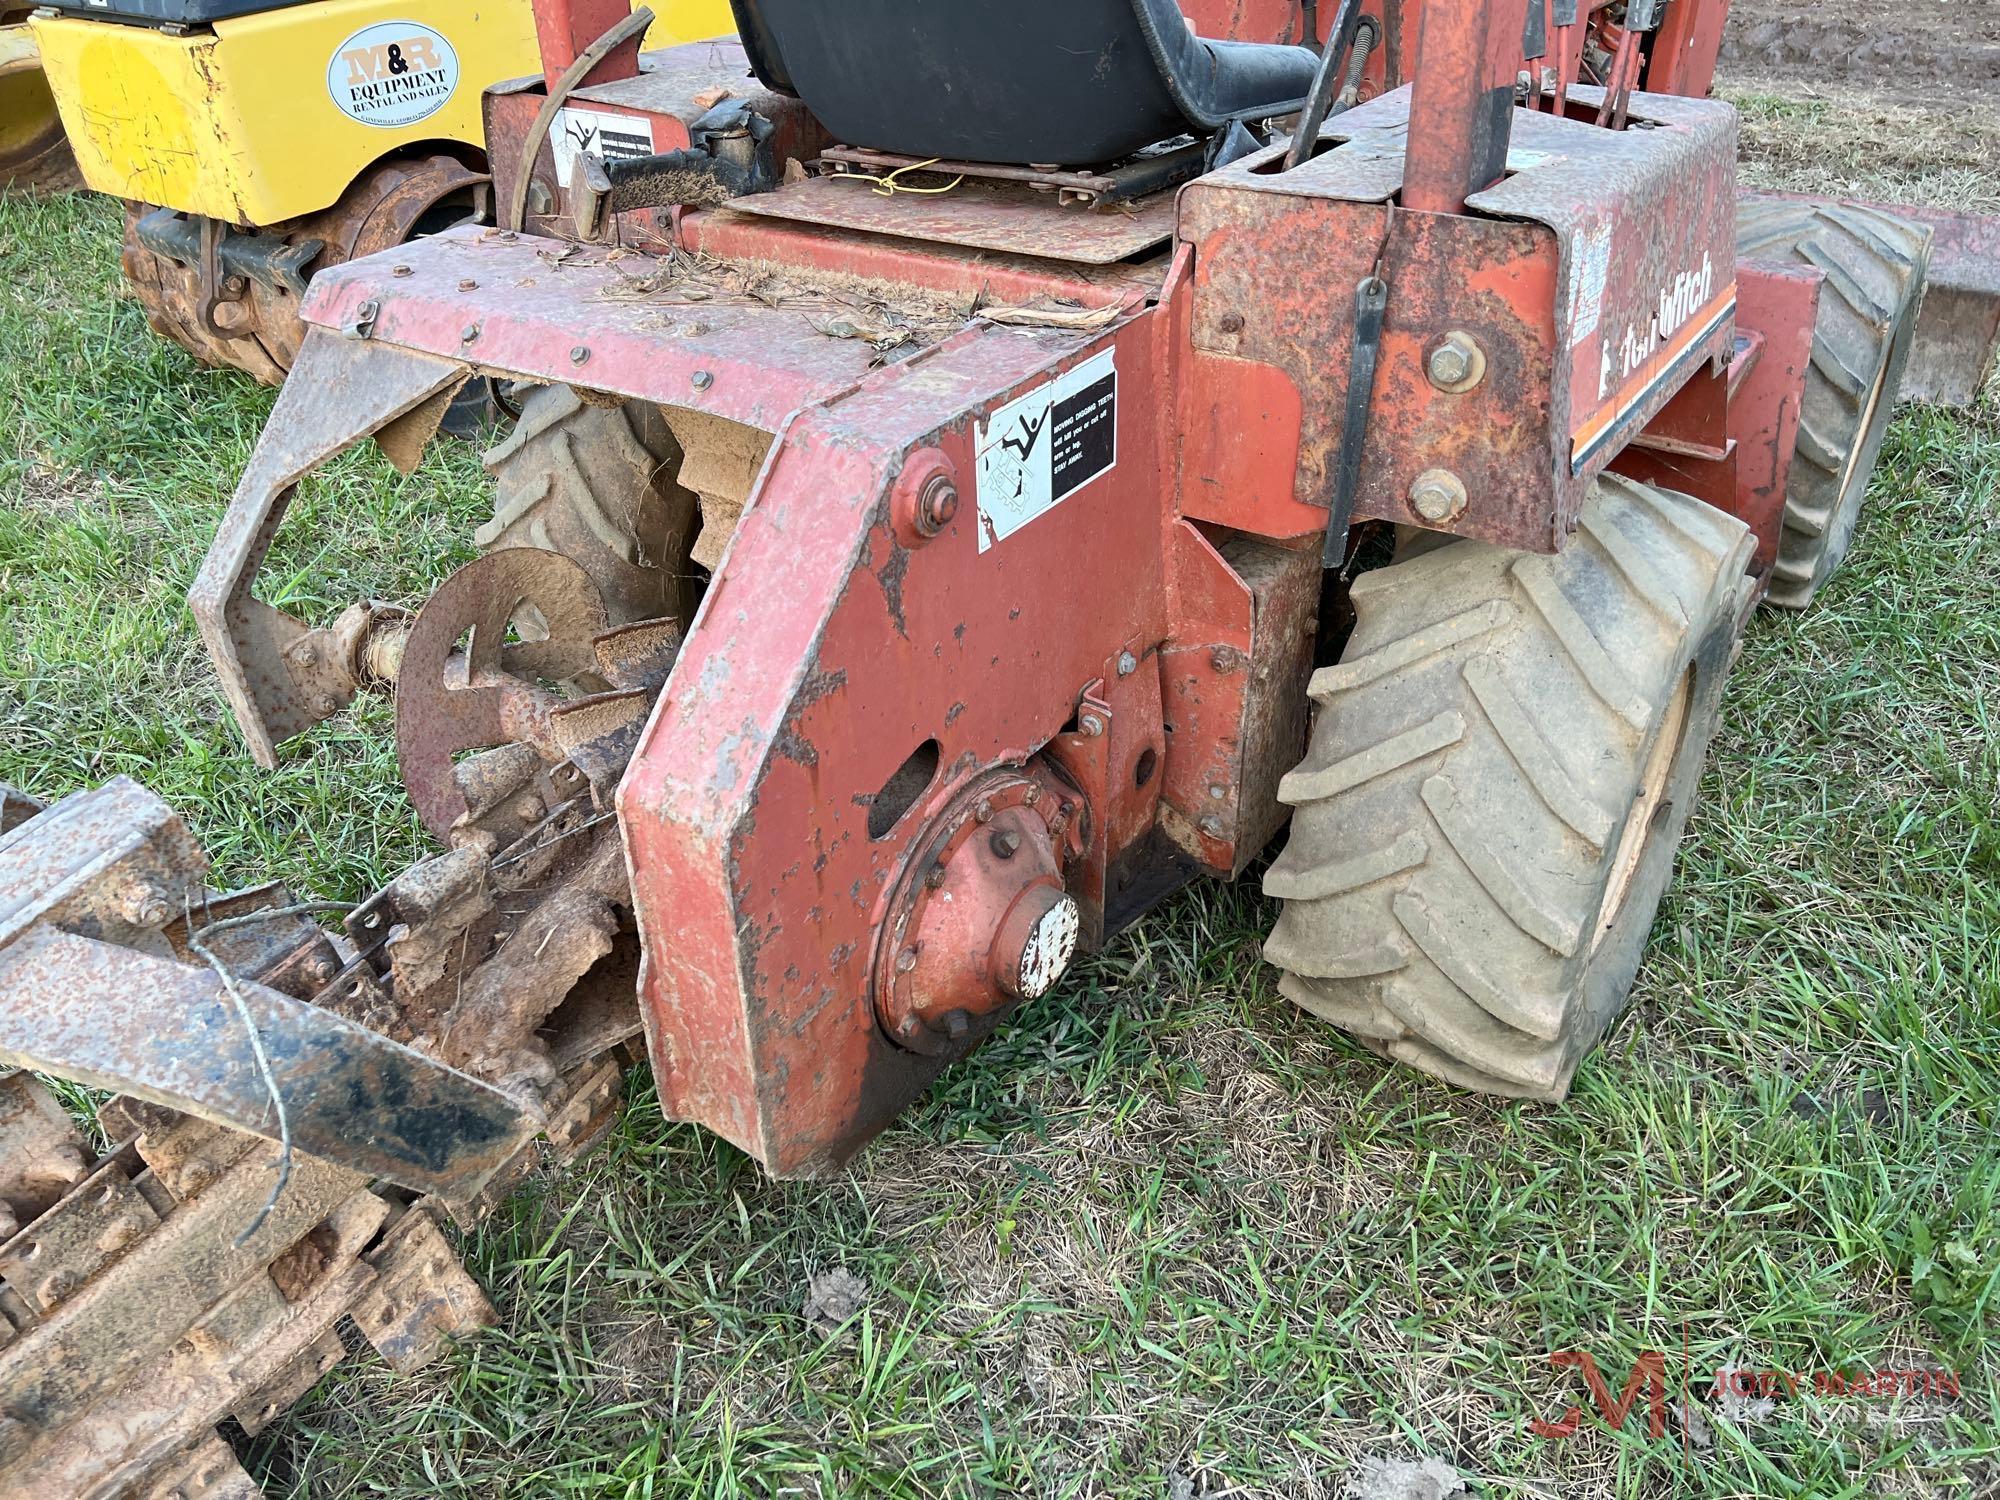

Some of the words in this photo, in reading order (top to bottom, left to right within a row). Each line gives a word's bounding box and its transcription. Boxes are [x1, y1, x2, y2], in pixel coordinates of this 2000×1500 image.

[342, 36, 441, 85] M&R
[350, 69, 446, 101] EQUIPMENT
[353, 97, 395, 113] RENTAL
[396, 91, 417, 104] AND
[419, 85, 449, 98] SALES
[1053, 416, 1074, 434] MOVING
[1075, 403, 1096, 420] DIGGING
[1097, 391, 1114, 407] TEETH
[1054, 437, 1063, 447] will
[1063, 430, 1072, 442] kill
[1073, 425, 1083, 438] you
[1083, 421, 1090, 429] or
[1090, 414, 1099, 425] cut
[1099, 409, 1107, 419] off
[1054, 451, 1064, 461] arm
[1064, 446, 1071, 454] or
[1054, 461, 1067, 474] STAY
